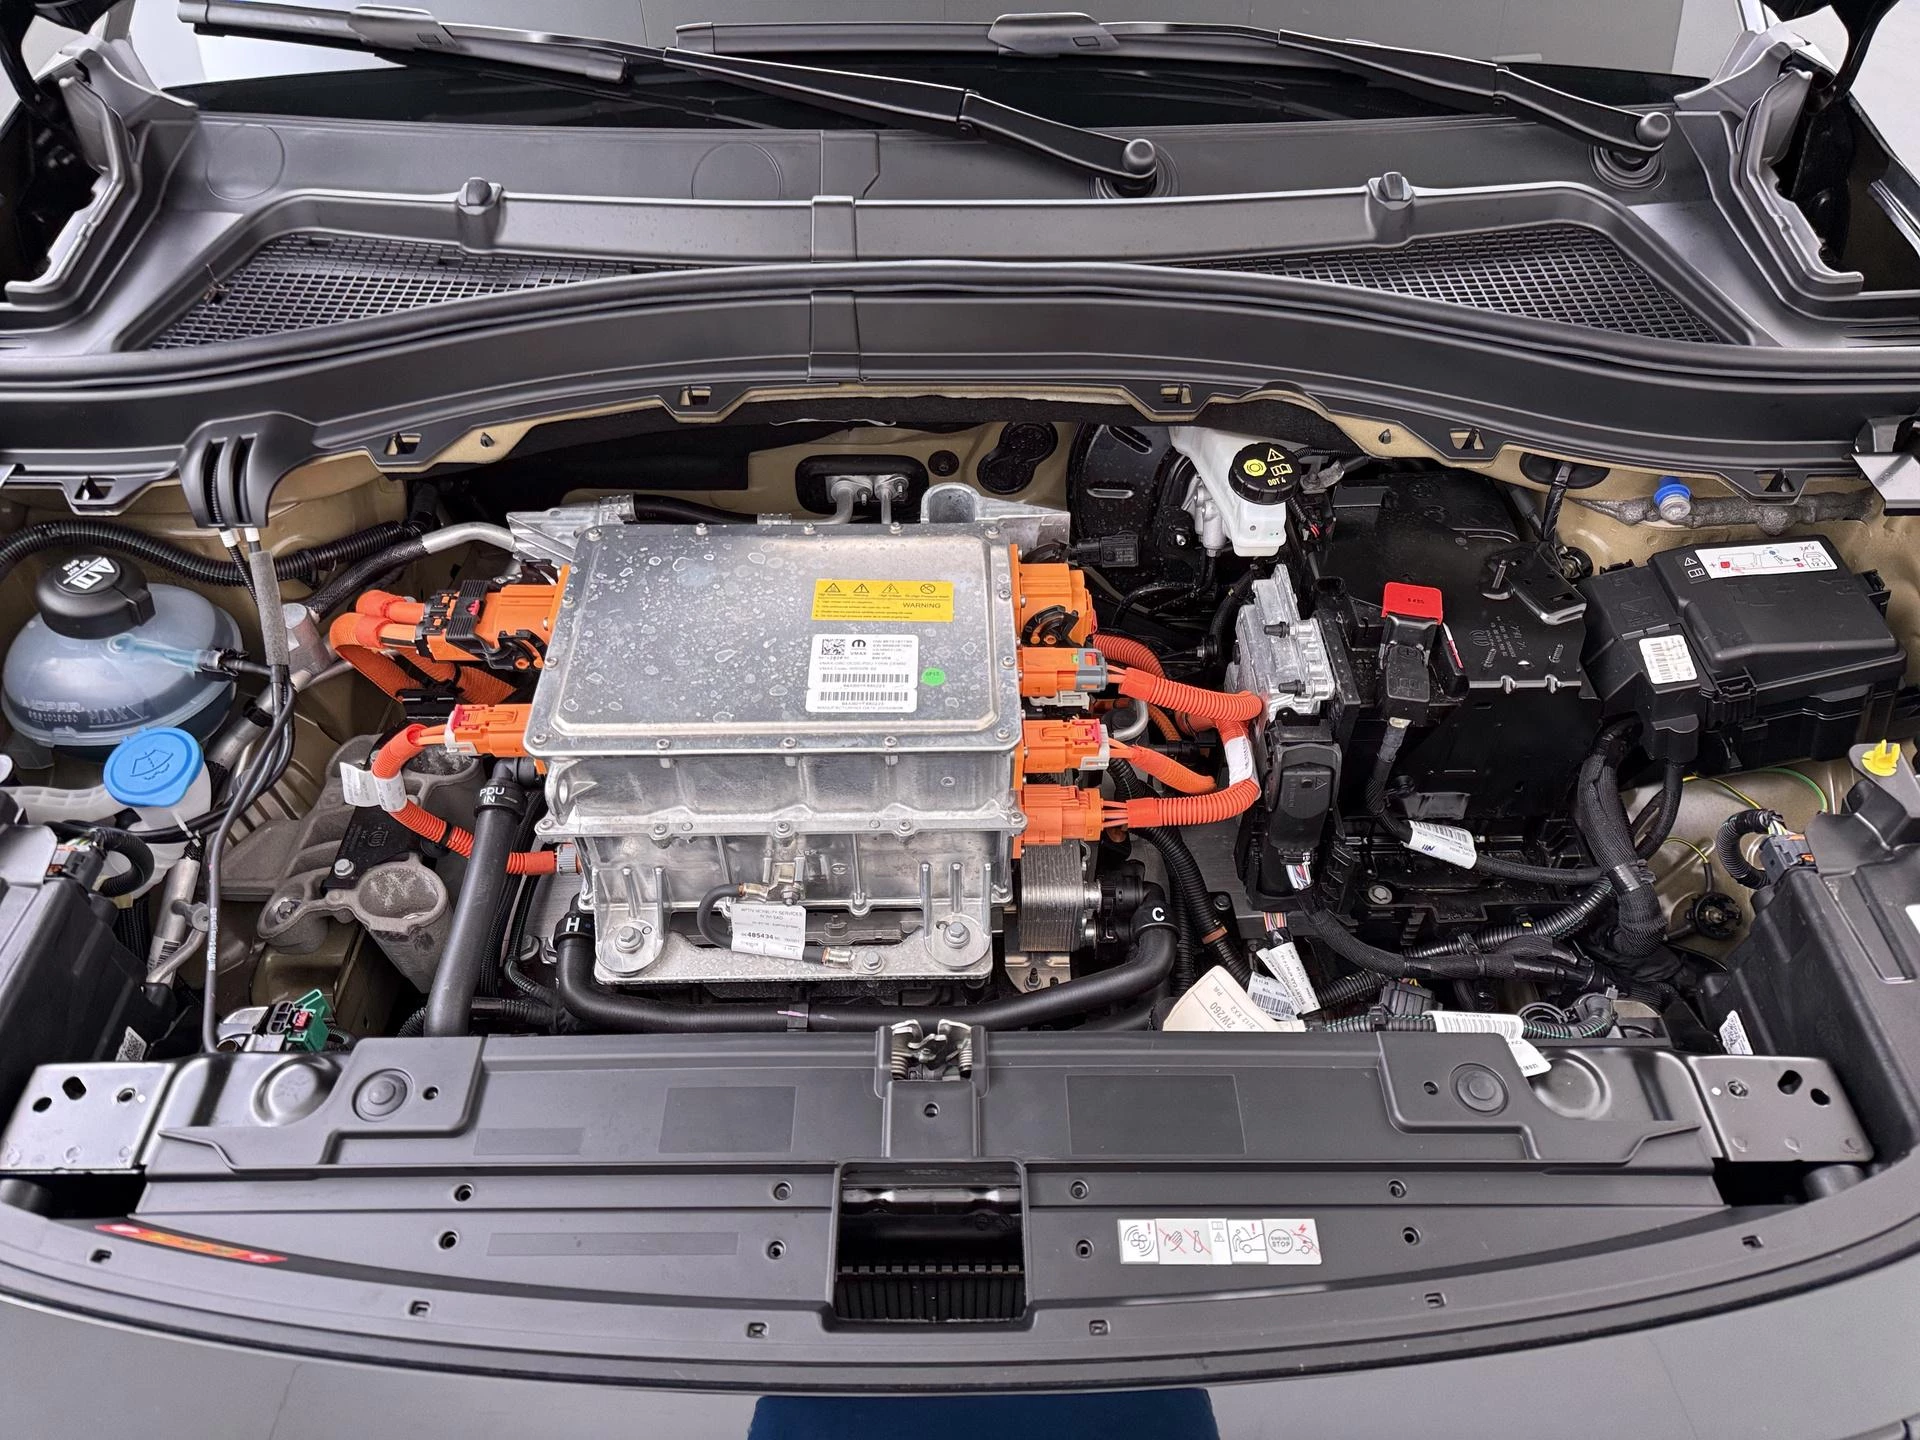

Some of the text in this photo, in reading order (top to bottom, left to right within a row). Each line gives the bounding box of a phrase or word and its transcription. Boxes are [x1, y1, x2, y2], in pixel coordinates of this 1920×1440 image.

[1267, 478, 1280, 487] DOT
[87, 705, 129, 724] MAX
[480, 786, 505, 797] PDU
[483, 795, 496, 804] IN
[1151, 907, 1166, 922] C
[566, 917, 580, 932] H
[1208, 1001, 1237, 1030] 2W260
